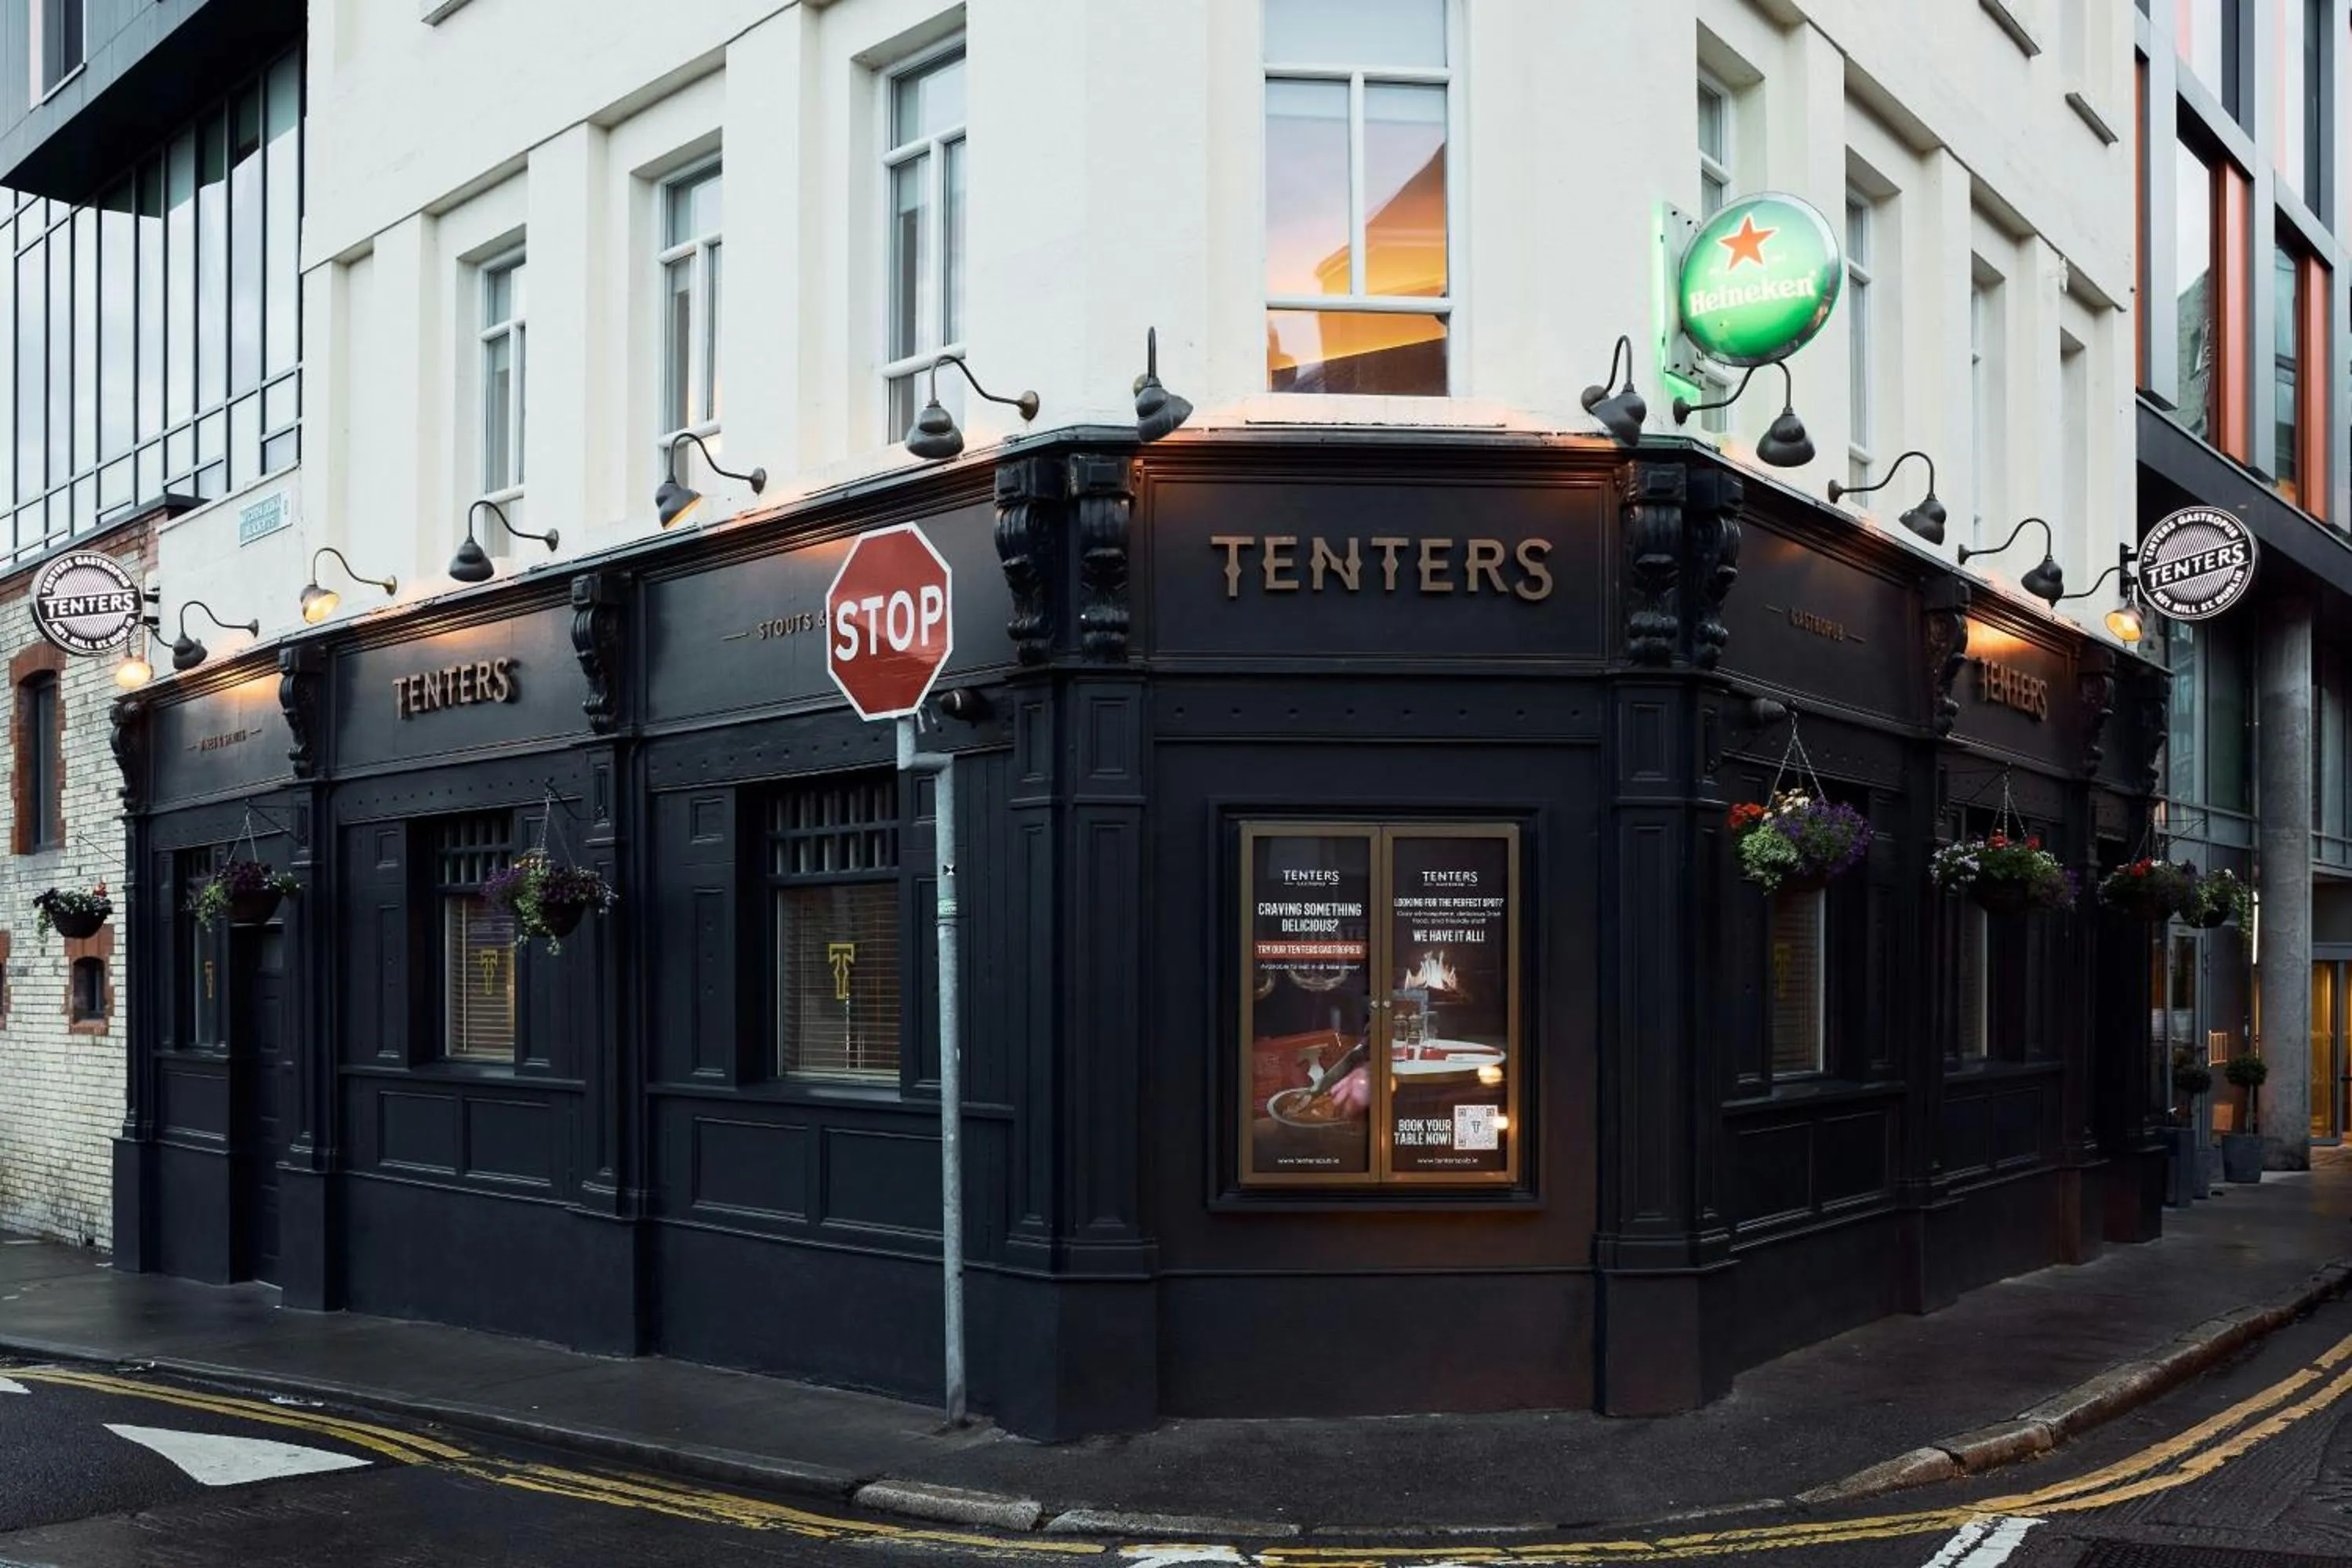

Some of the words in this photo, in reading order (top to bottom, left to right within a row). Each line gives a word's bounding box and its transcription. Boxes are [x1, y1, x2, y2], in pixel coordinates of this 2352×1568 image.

[1690, 274, 1817, 318] Heineken
[2143, 521, 2176, 562] TENTERS
[2177, 512, 2239, 539] GASTROPUB
[42, 559, 74, 593] TENTERS
[74, 555, 132, 588] GASTROPUB
[1210, 535, 1555, 601] TENTERS
[2147, 543, 2245, 588] TENTERS
[2172, 602, 2198, 614] MILL
[2215, 570, 2245, 604] DUBLIN
[44, 593, 136, 619] TENTERS
[758, 614, 811, 640] STOUTS
[834, 585, 944, 662] STOP
[393, 657, 510, 720] TENTERS
[1980, 659, 2048, 721] TENTERS
[1282, 869, 1340, 882] TENTERS
[1421, 871, 1478, 884] TENTERS
[1258, 902, 1301, 916] CRAVING
[1304, 902, 1362, 916] SOMETHING
[1393, 898, 1423, 907] LOOKING
[1425, 898, 1437, 907] FOR
[1439, 898, 1452, 907] THE
[1453, 898, 1482, 907] PERFECT
[1282, 919, 1340, 932] DELICIOUS?
[1413, 930, 1428, 942] WE
[1429, 930, 1454, 942] HAVE
[1455, 930, 1465, 942] IT
[1465, 930, 1484, 942] ALL!
[1258, 945, 1271, 954] TRY
[1271, 945, 1286, 954] OUR
[1287, 945, 1317, 954] TENTERS
[1394, 1131, 1425, 1145] TABLE
[1426, 1131, 1451, 1145] NOW!
[1398, 1119, 1425, 1131] BOOK
[1426, 1119, 1452, 1131] YOUR
